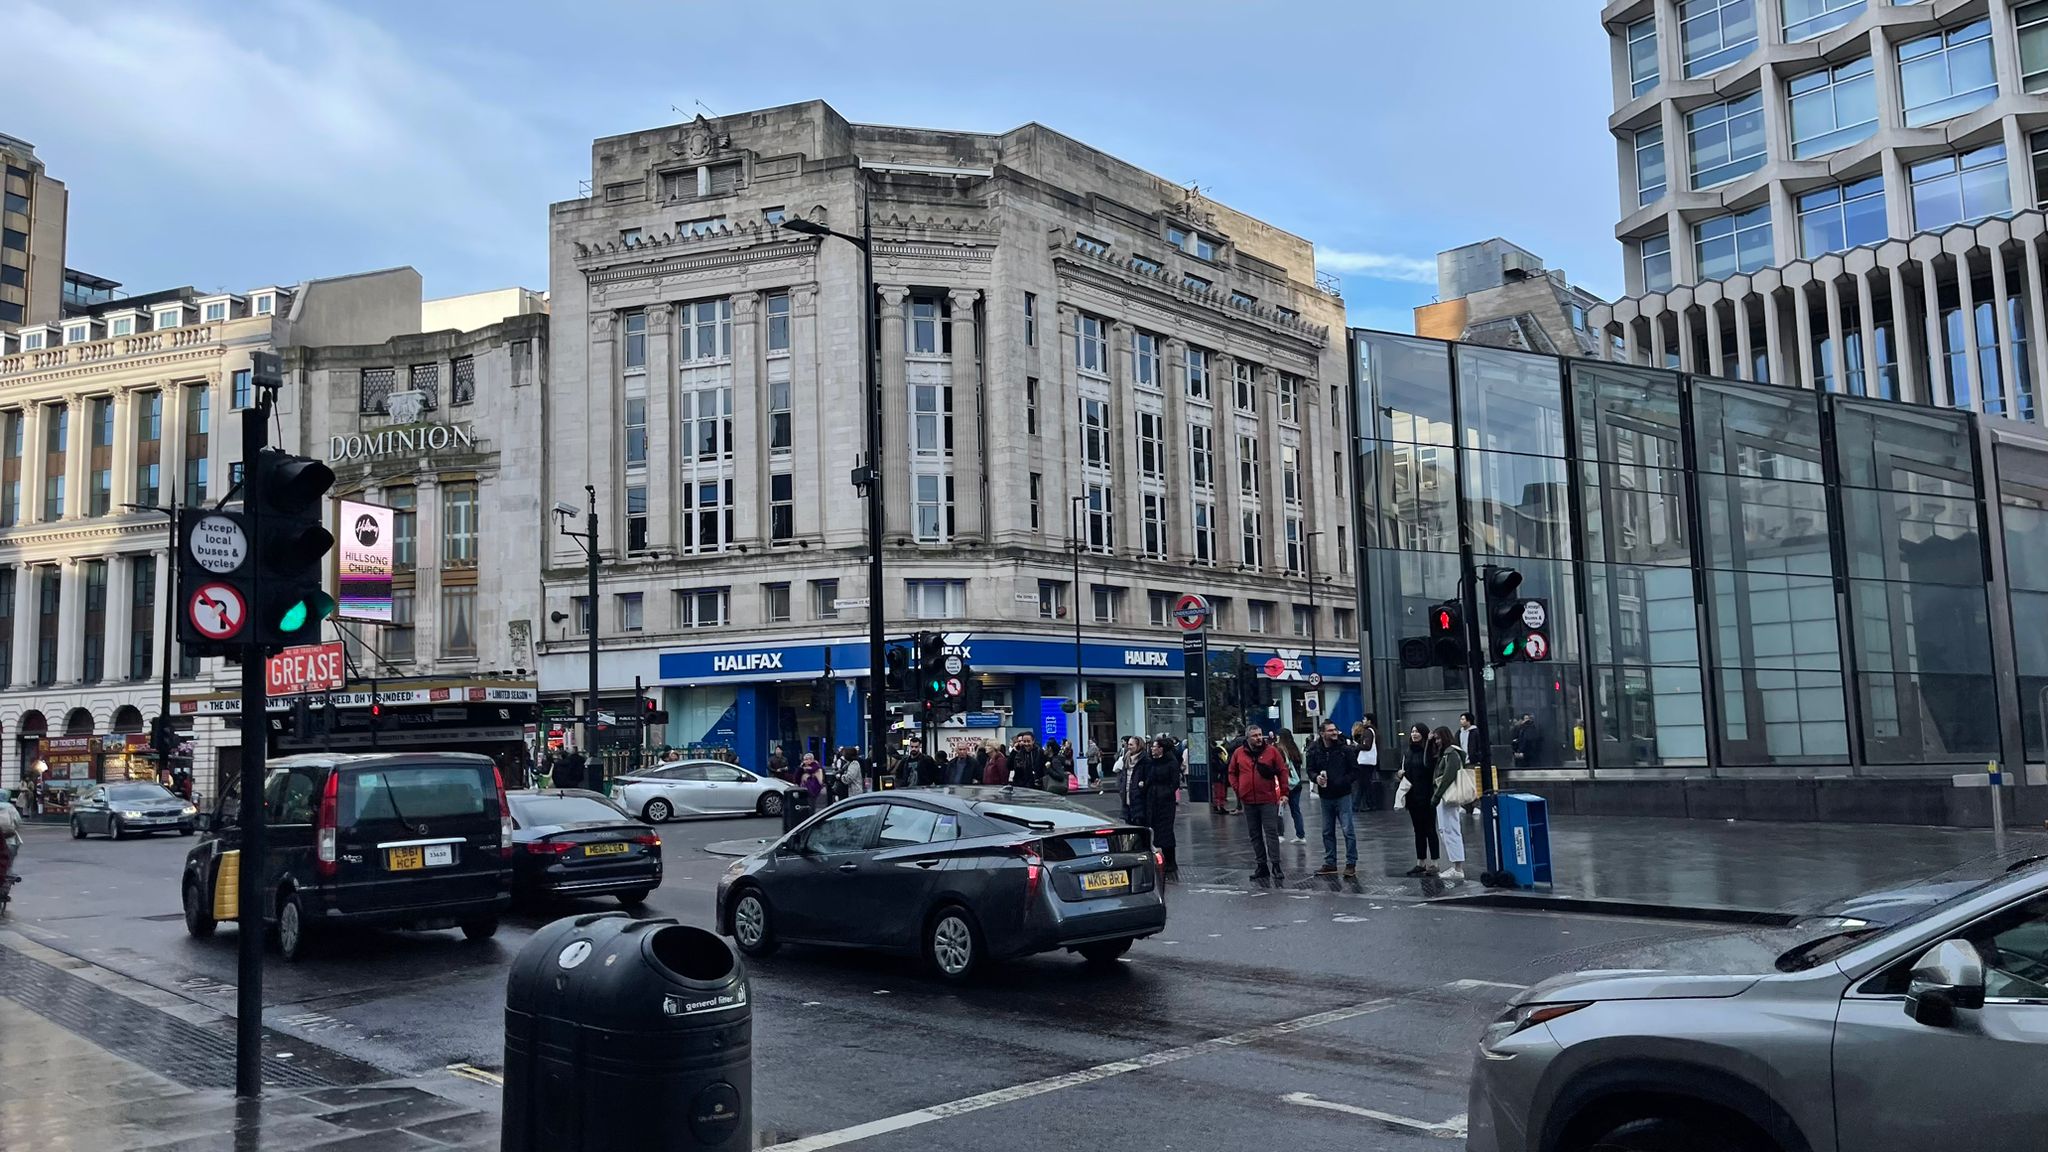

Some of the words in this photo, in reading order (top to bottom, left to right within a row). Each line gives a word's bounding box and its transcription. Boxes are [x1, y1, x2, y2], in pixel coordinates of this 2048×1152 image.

[329, 424, 472, 462] DOMINION
[200, 521, 237, 534] Except
[206, 534, 231, 545] local
[198, 545, 229, 556] buses
[232, 548, 239, 557] &
[201, 559, 235, 568] cycles
[345, 551, 388, 565] HILLSONG
[348, 562, 385, 575] CHURCH
[1173, 608, 1205, 617] UNDERGROUND
[714, 652, 783, 671] HALIFAX
[1125, 651, 1168, 666] HALIFAX
[271, 652, 339, 686] GREASE
[1310, 675, 1319, 683] 20
[210, 701, 224, 710] THE
[225, 699, 240, 710] ONE
[354, 692, 365, 700] OH
[382, 691, 414, 701] INDEED!
[492, 690, 510, 699] LIMITED
[511, 690, 528, 700] SEASON
[685, 997, 717, 1011] general
